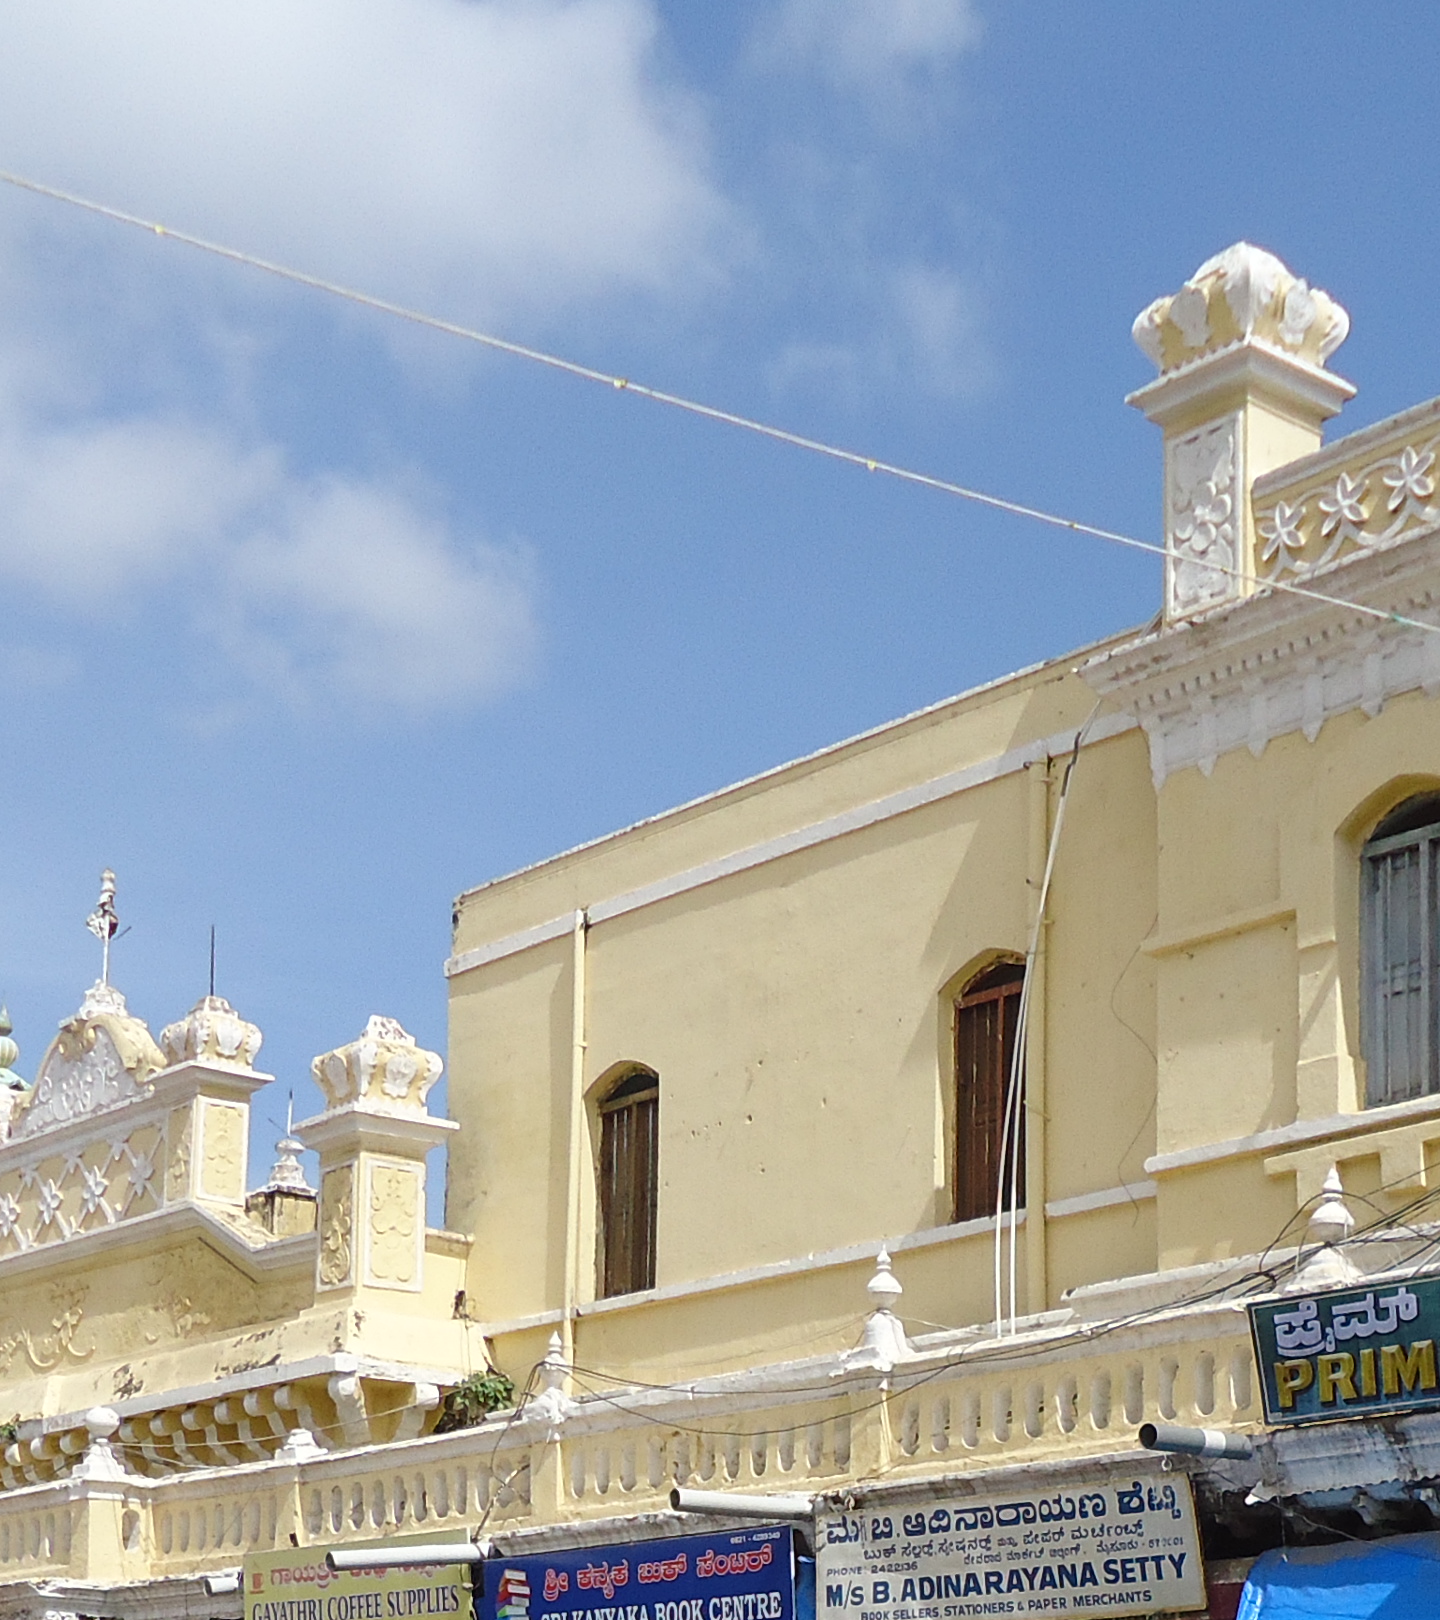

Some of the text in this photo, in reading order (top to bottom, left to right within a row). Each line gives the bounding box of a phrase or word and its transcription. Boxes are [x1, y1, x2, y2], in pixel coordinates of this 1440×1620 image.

[1273, 1287, 1418, 1357] ಪ್ರೈಮ್
[903, 1493, 1106, 1537] ಆದಿನಾರಾಯಣ
[542, 1543, 772, 1601] ಶ್ರೀ ಕನ್ಯಕ ಬುಕ್ ಸೆಂಟರ್
[872, 1581, 897, 1604] B.
[900, 1561, 1099, 1602] ADINARAYANA
[1103, 1552, 1187, 1585] SETTY
[387, 1584, 459, 1616] SUPPLIES
[893, 1606, 942, 1620] SELLERS,
[944, 1601, 1014, 1616] STATIONERS
[1028, 1598, 1067, 1611] PAPER
[1073, 1590, 1152, 1607] MERCHANTS
